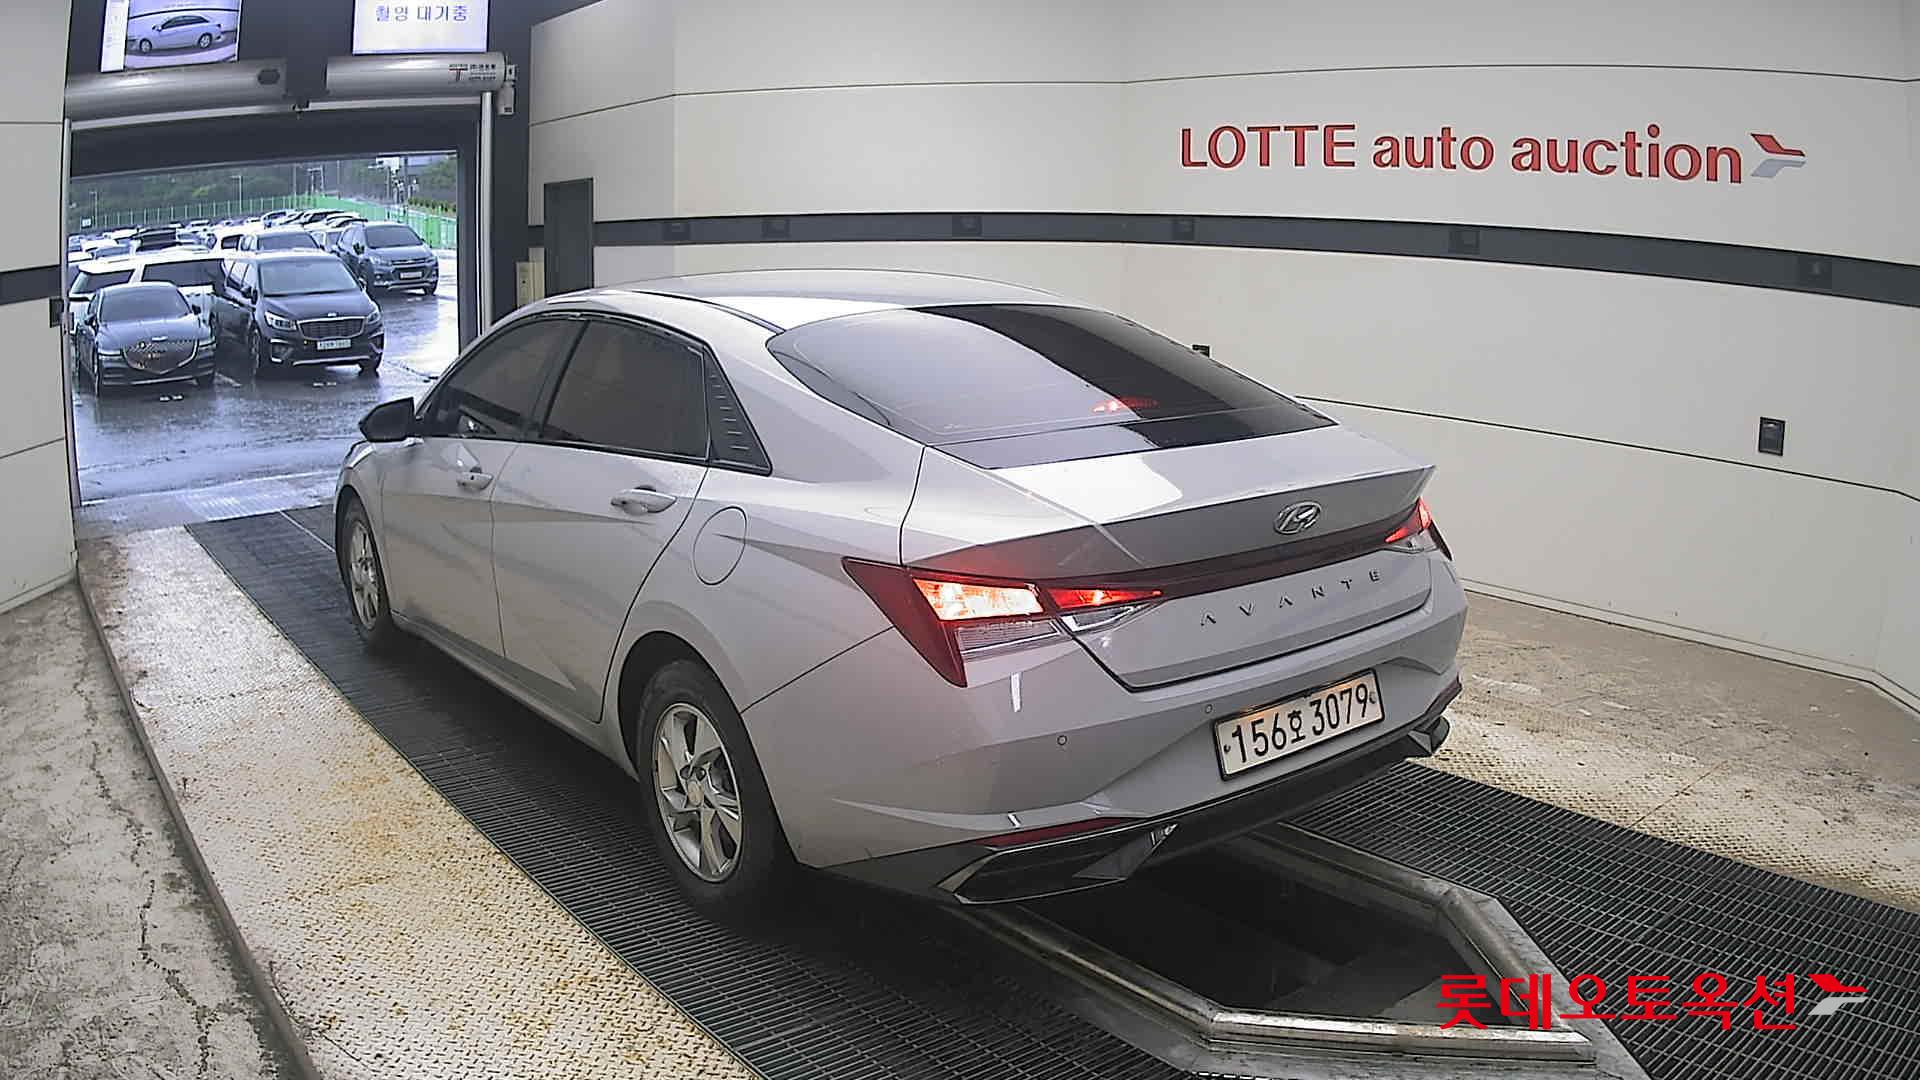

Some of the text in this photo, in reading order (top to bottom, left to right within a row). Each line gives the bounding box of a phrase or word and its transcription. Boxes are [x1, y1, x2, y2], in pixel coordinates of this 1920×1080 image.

[1180, 123, 1743, 184] LOTTE auto auction
[1200, 569, 1382, 627] AVANTE
[1309, 683, 1369, 736] 3079
